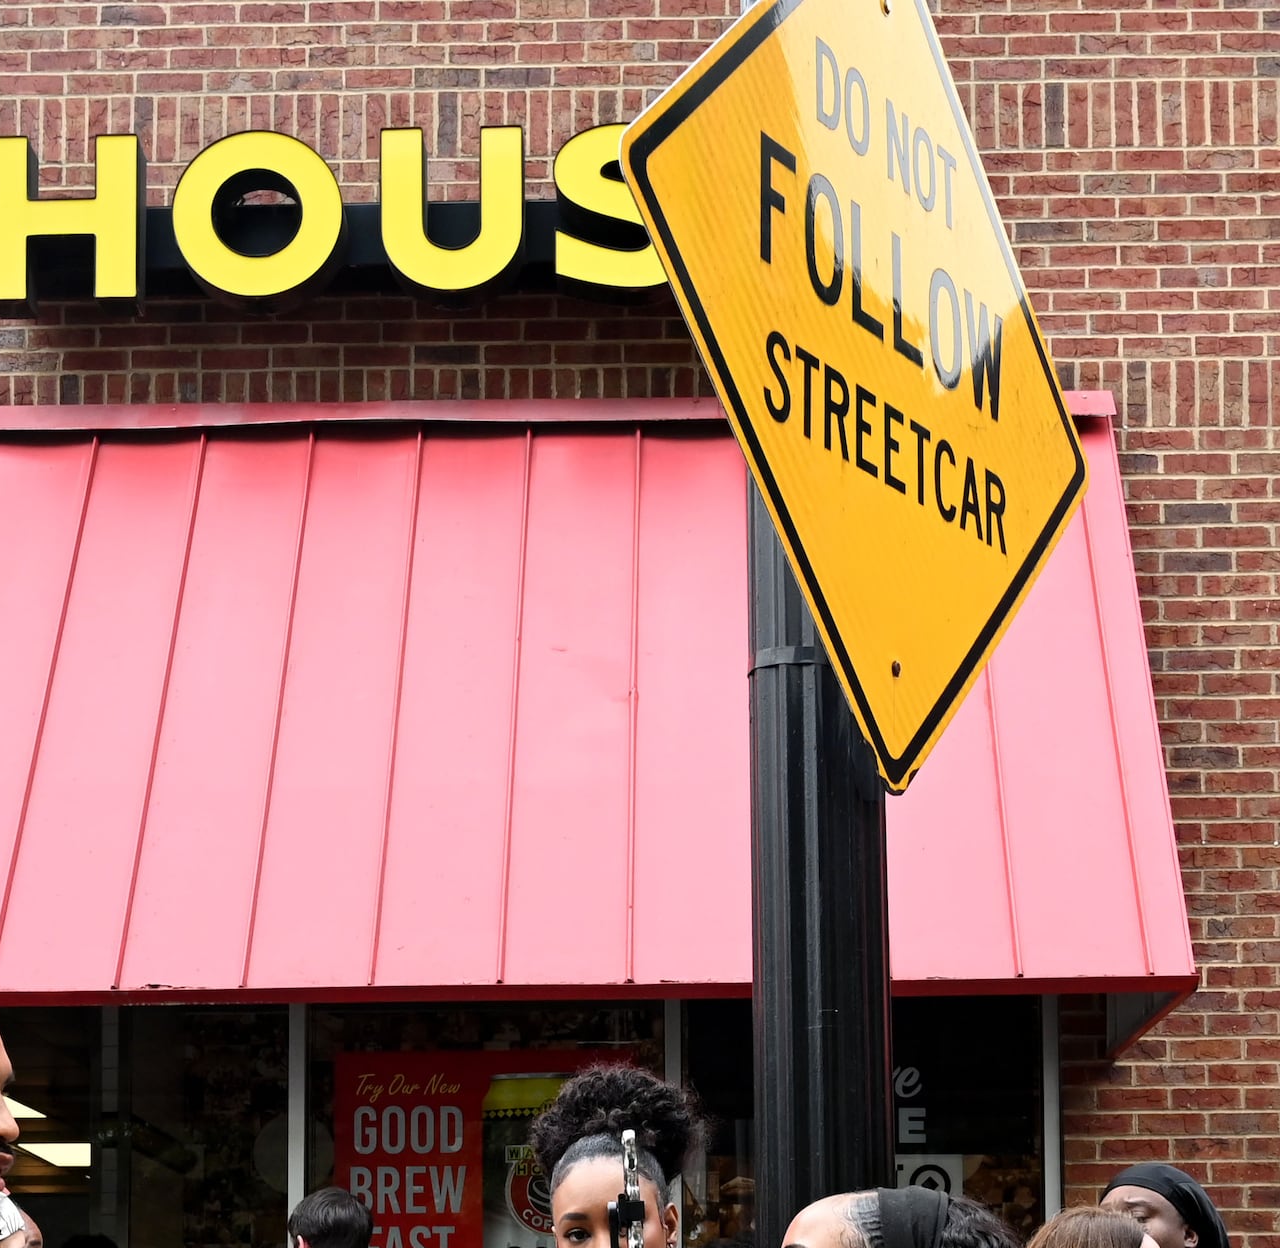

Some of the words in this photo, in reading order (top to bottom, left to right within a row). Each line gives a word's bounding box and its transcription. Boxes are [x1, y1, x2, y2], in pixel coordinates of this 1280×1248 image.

[815, 35, 870, 156] DO
[886, 97, 956, 228] NOT
[760, 130, 1004, 422] FOLLOW
[763, 330, 1008, 556] STREETCAR
[354, 1105, 464, 1155] GOOD
[355, 1073, 385, 1104] Try
[388, 1073, 421, 1096] Our
[423, 1072, 461, 1096] New
[349, 1166, 467, 1214] BREW
